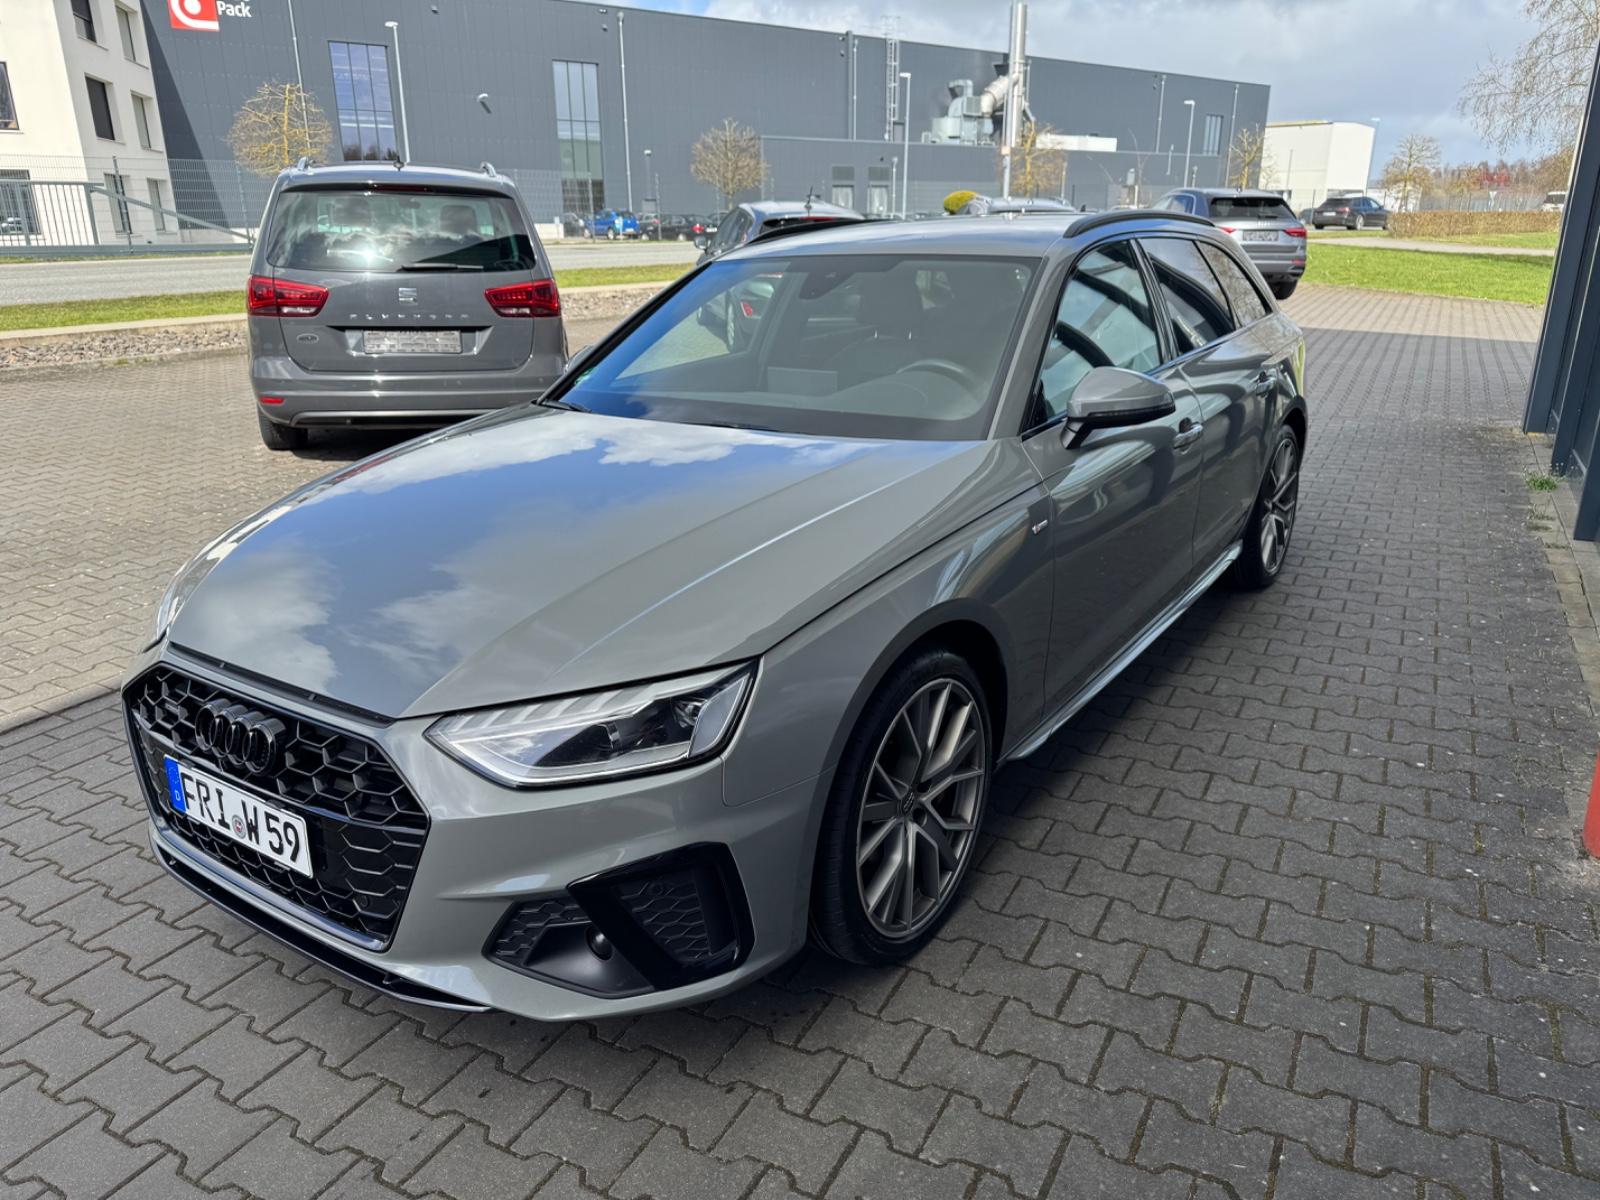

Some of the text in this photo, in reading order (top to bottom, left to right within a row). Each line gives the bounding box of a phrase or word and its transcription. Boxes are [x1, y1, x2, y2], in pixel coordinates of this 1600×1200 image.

[216, 1, 252, 18] Pack
[180, 772, 300, 863] FRI W 59
